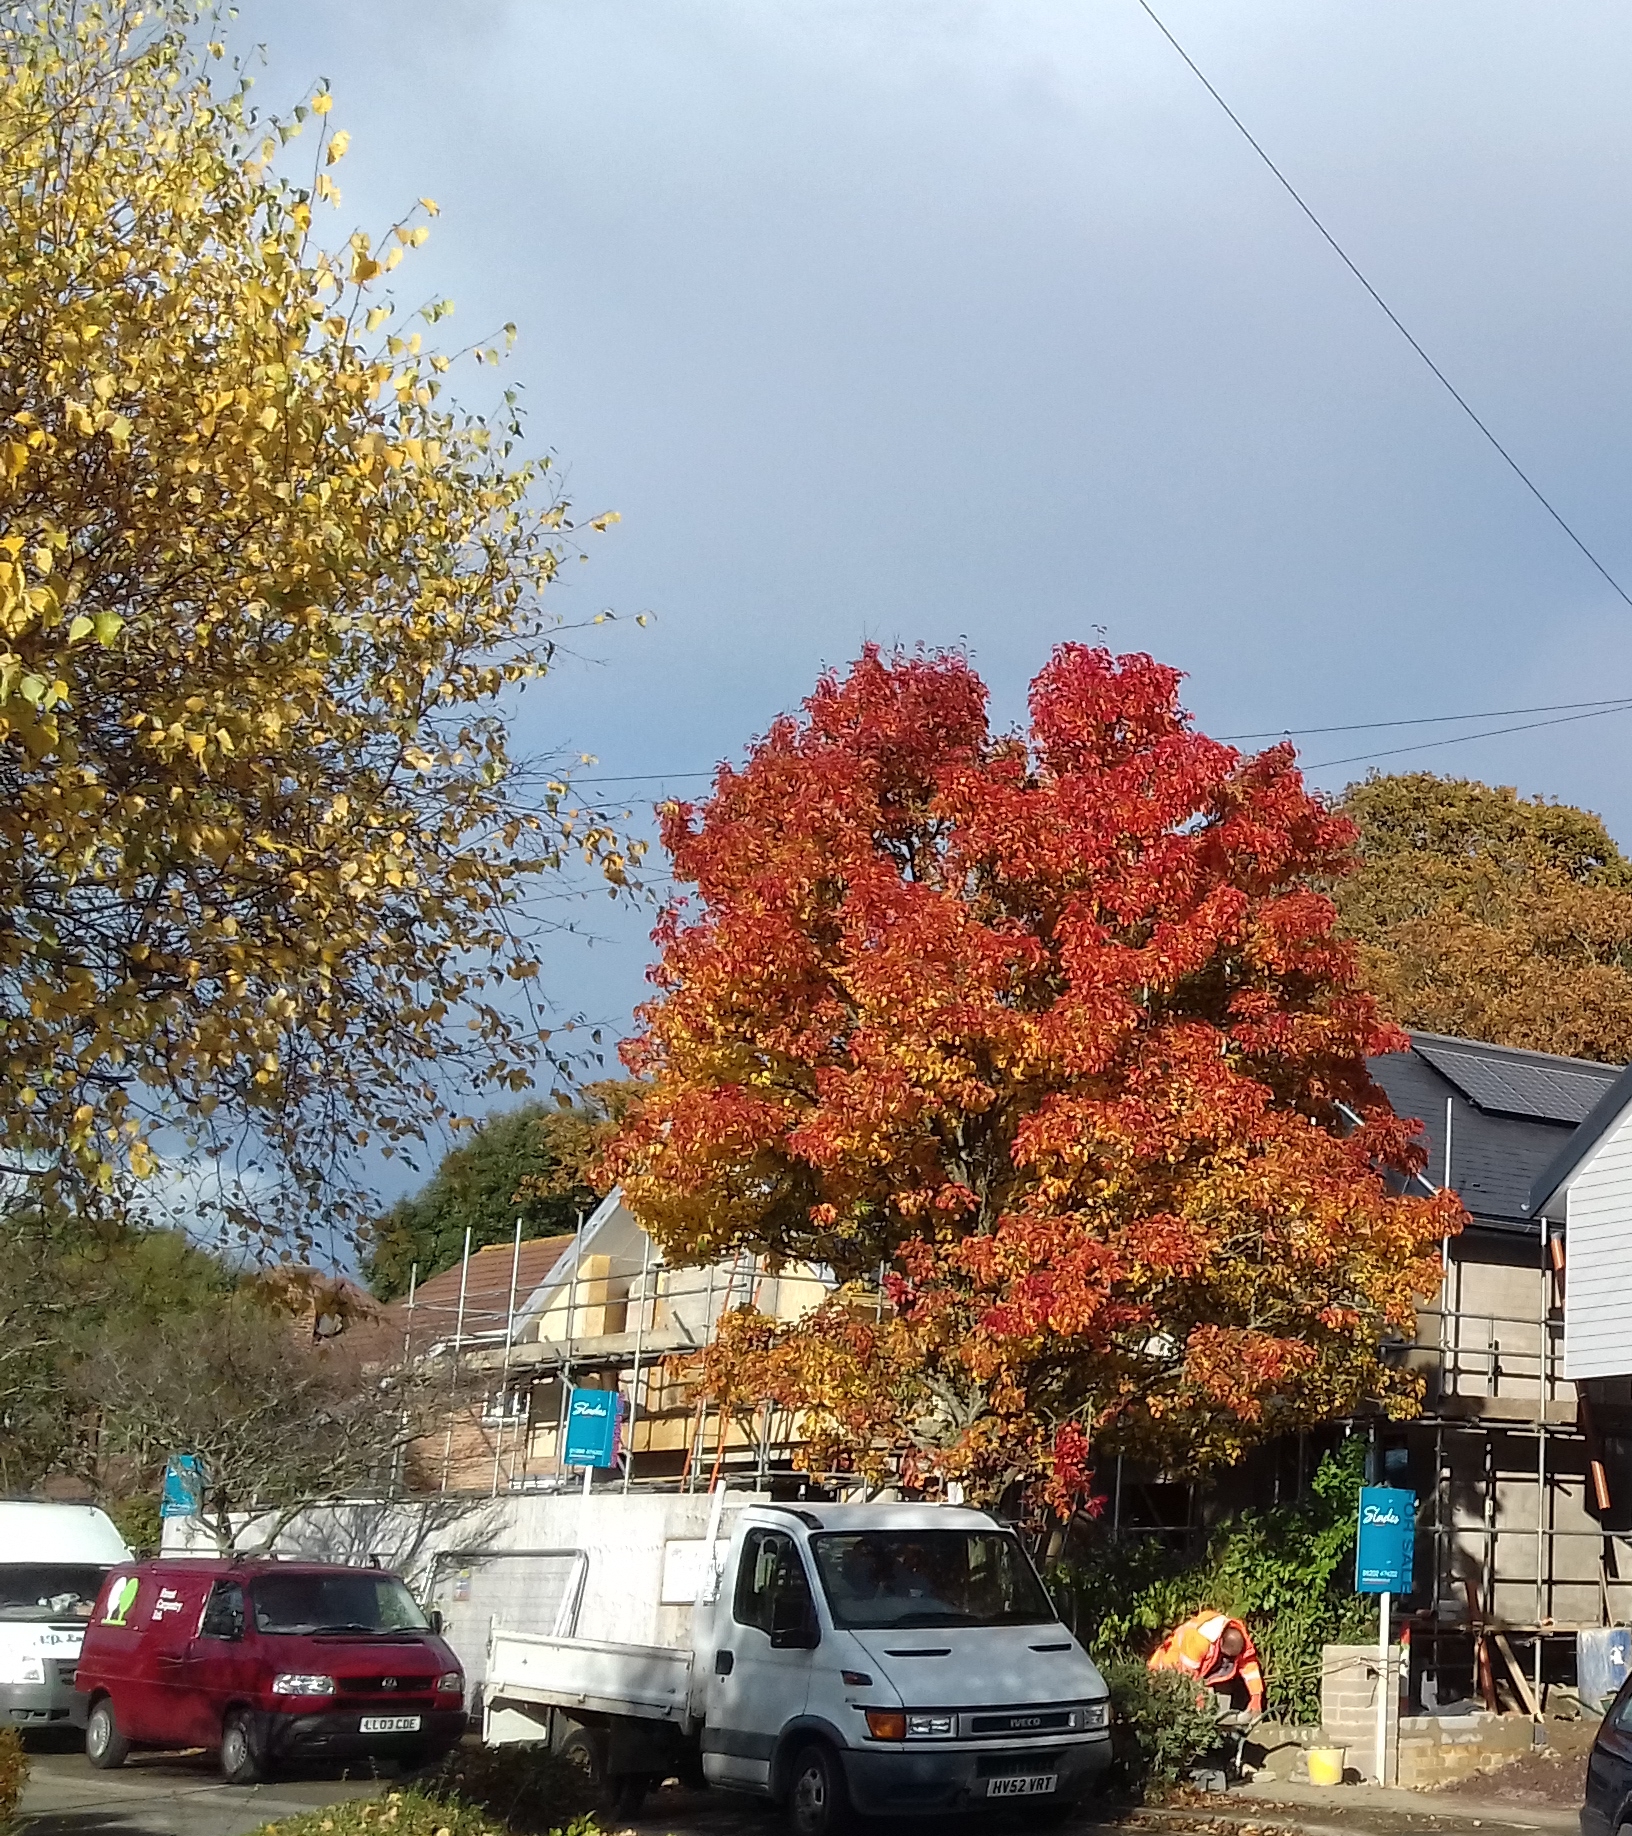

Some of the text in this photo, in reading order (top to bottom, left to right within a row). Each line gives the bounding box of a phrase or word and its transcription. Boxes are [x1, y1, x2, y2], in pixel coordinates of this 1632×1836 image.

[1401, 1490, 1416, 1593] FOR SALE
[1011, 1717, 1041, 1728] IVECO
[993, 1778, 1027, 1794] HV52
